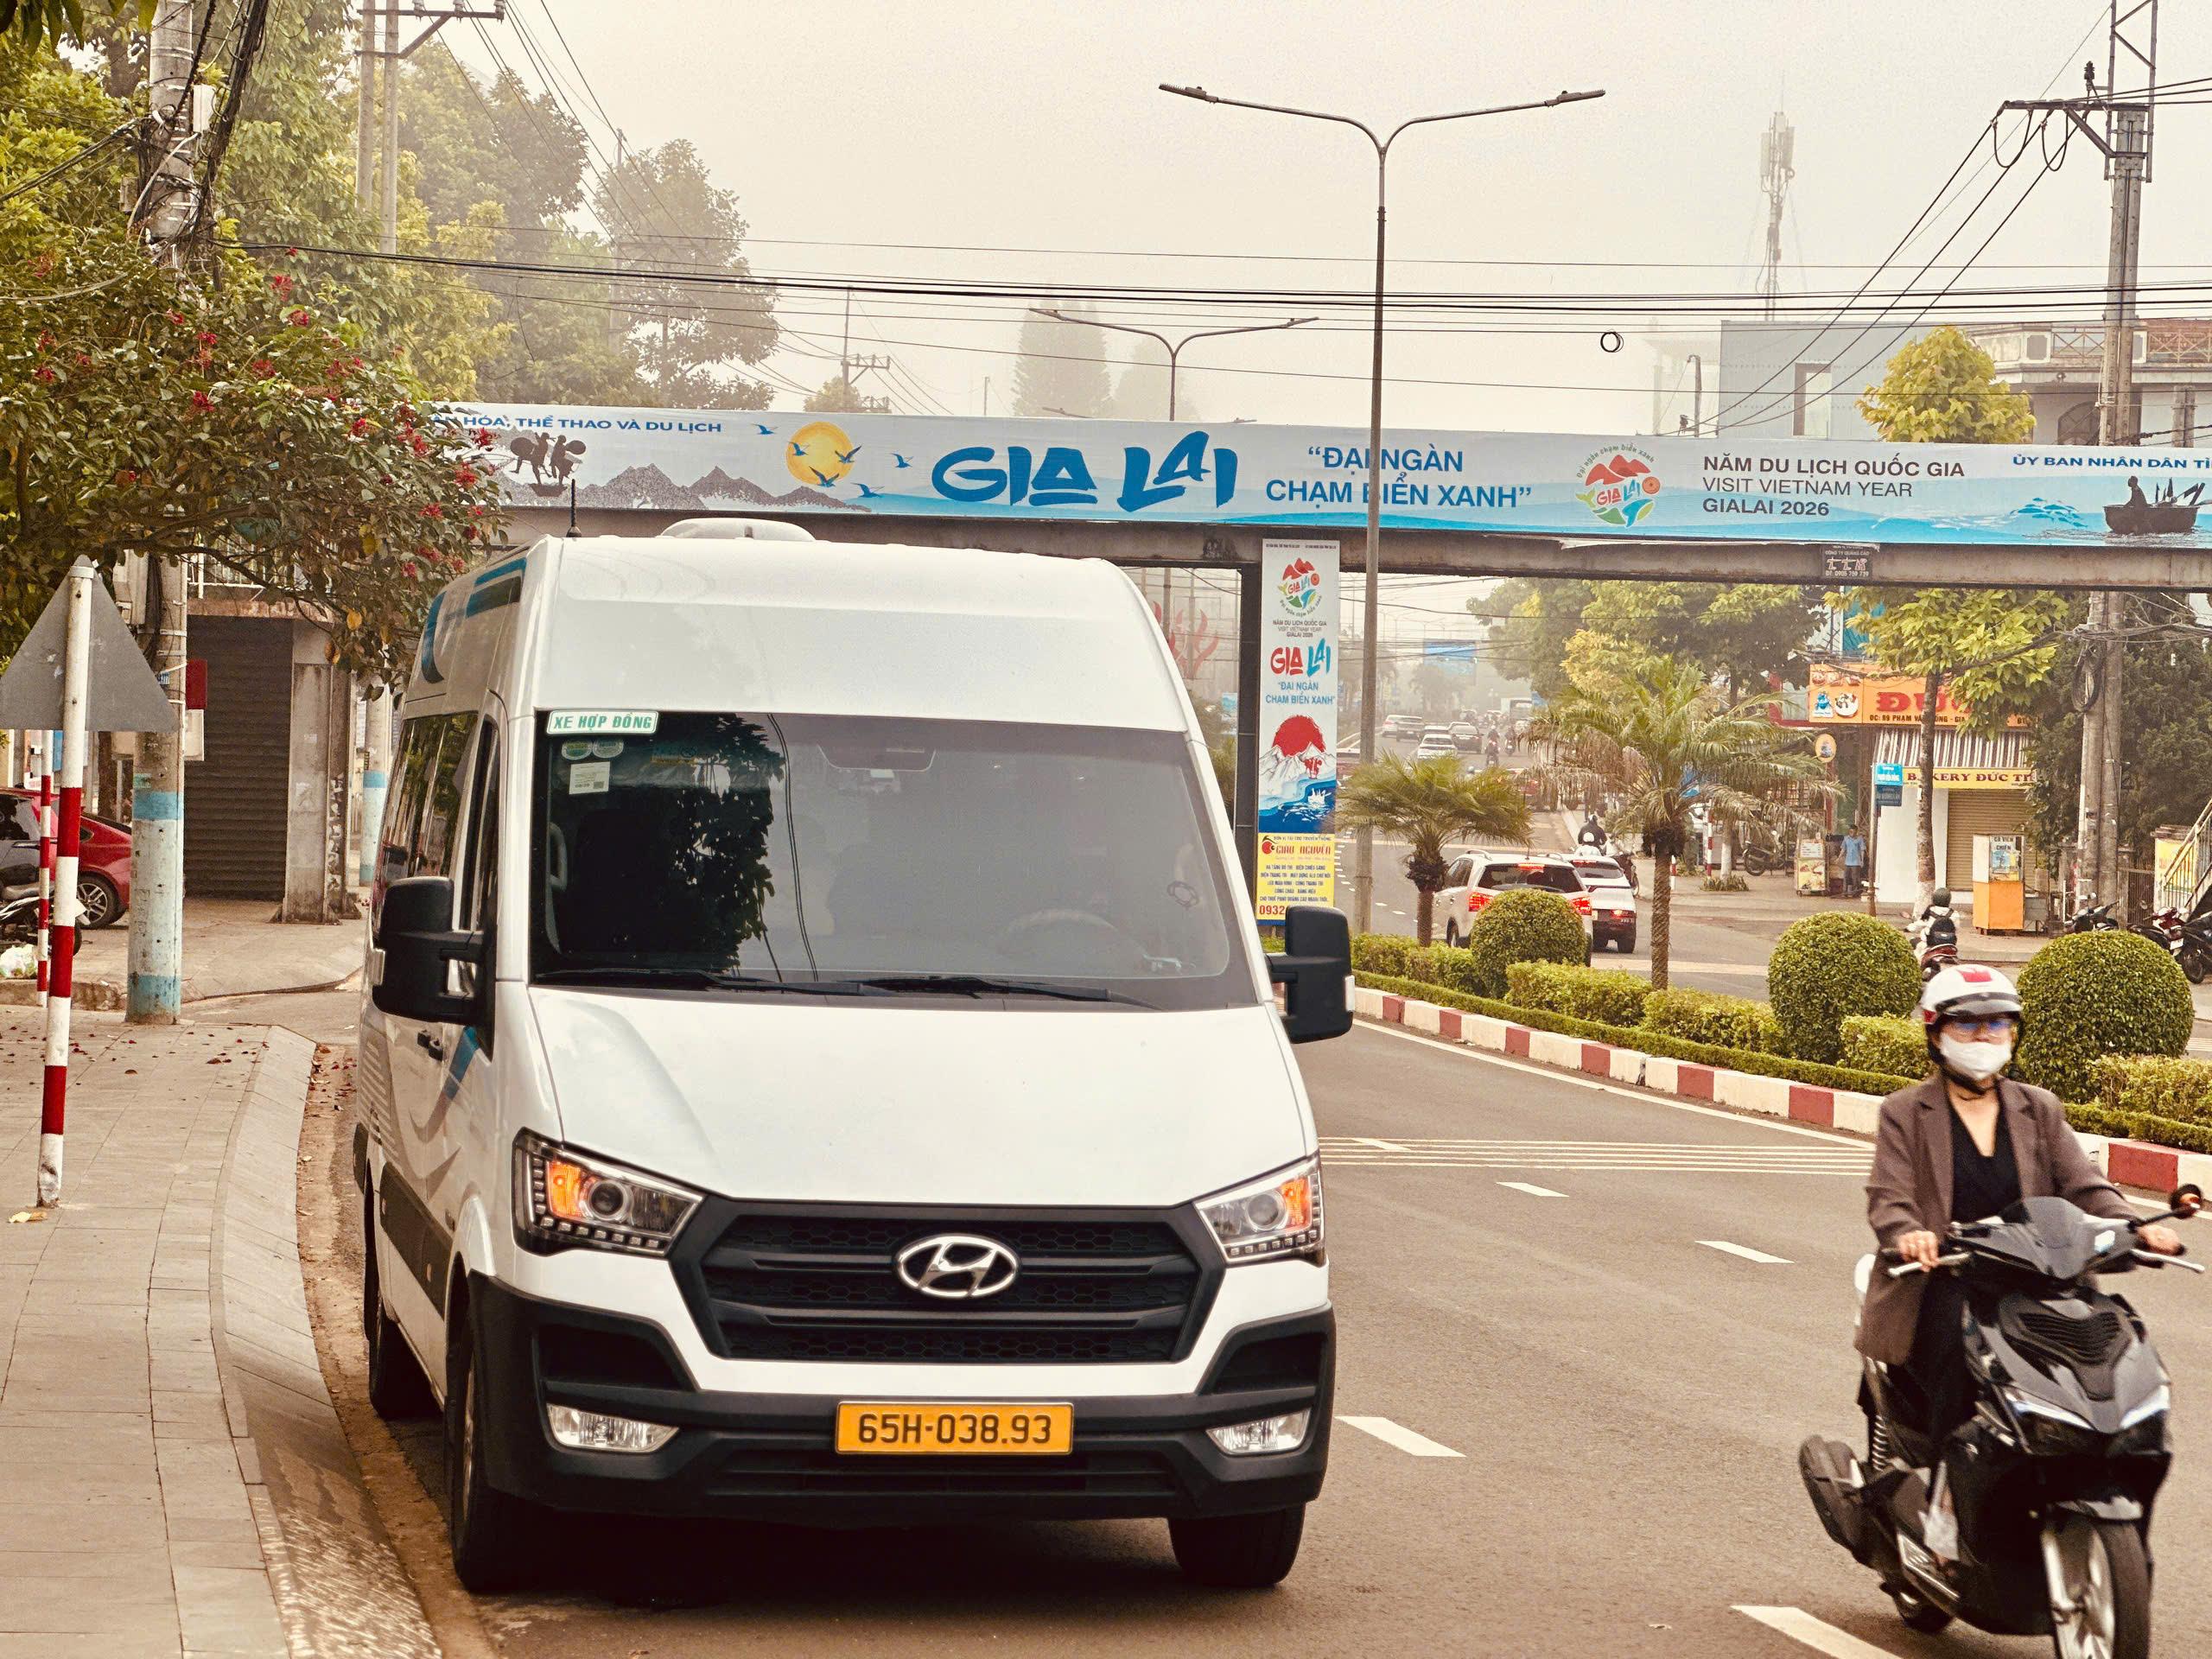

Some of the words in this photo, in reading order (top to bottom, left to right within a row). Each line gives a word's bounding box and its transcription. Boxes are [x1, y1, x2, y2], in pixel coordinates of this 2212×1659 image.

[558, 418, 612, 429] THAO
[617, 419, 640, 430] VÀ
[646, 422, 673, 431] DU
[678, 423, 721, 434] LỊCH
[1381, 443, 1463, 473] NGÀN
[1704, 454, 1751, 472] NĂM
[1760, 458, 1789, 473] DU
[1797, 459, 1847, 478] LỊCH
[1854, 452, 1919, 476] QUỐC
[1927, 462, 1965, 477] GIA
[2044, 457, 2082, 467] BAN
[2088, 456, 2142, 467] NHÂN
[2148, 457, 2187, 468] DÂN
[931, 446, 1098, 506] GIA
[1117, 430, 1238, 513] LAI
[1266, 479, 1351, 509] CHẠM
[1596, 487, 1622, 505] GIA
[1624, 480, 1640, 501] LAI
[1703, 477, 1753, 493] VISIT
[1759, 479, 1851, 495] VIETNAM
[1858, 481, 1912, 497] YEAR
[1703, 499, 1773, 514] GIALAI
[1781, 501, 1829, 516] 2026
[1287, 582, 1300, 594] GIA
[1270, 646, 1304, 676] GIA
[1306, 638, 1331, 678] LAI
[554, 715, 574, 728] XE
[578, 714, 607, 731] HỢP
[613, 712, 652, 728] ĐỒNG
[1907, 772, 1970, 782] BKERY
[1259, 905, 1285, 915] 0932
[858, 1413, 1052, 1445] 65H-038.93
